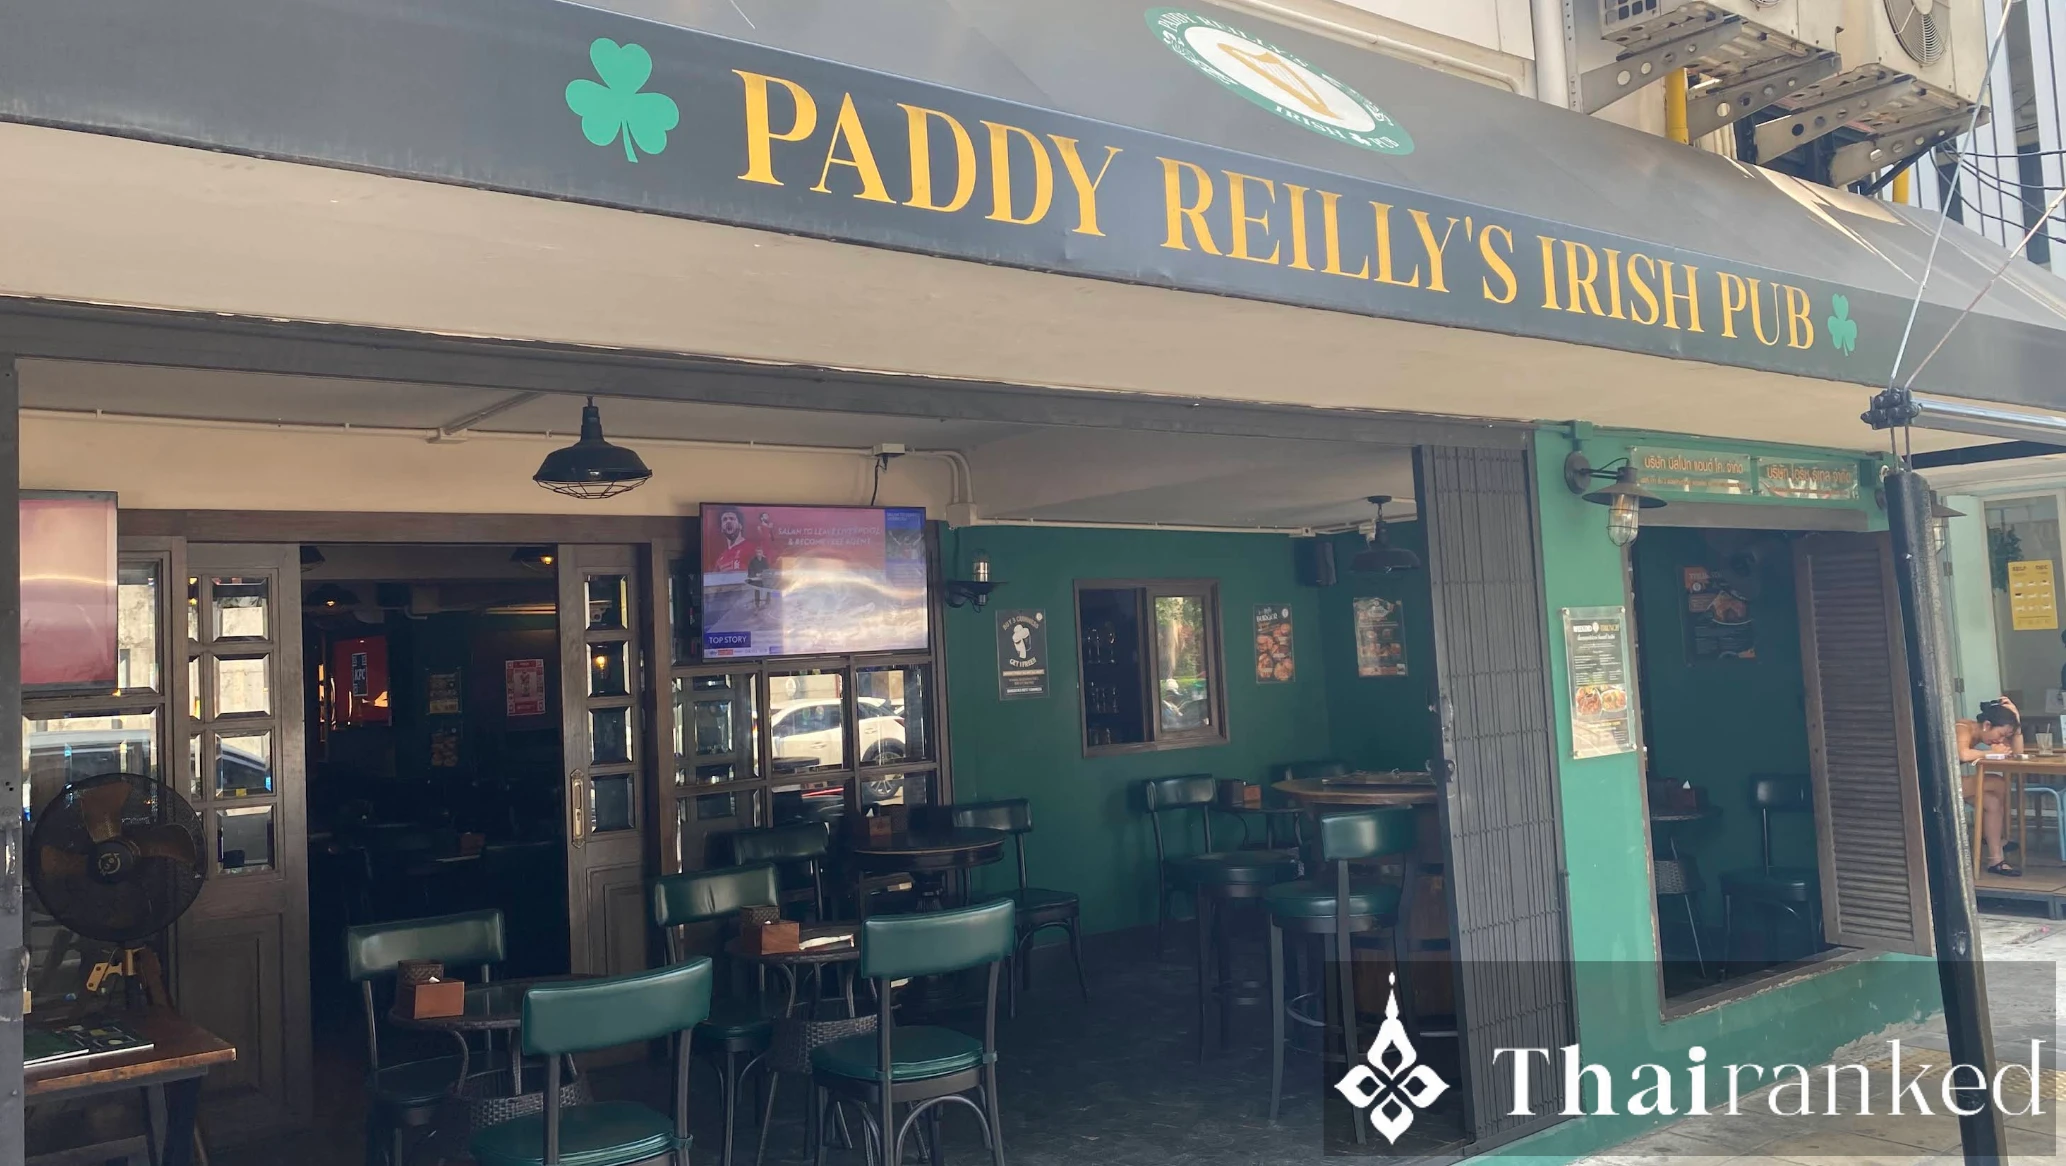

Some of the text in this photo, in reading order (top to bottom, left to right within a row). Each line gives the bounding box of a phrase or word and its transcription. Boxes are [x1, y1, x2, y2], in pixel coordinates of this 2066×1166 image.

[1158, 12, 1309, 67] PADDY REILLY'S
[1275, 105, 1400, 149] IRISH PUB
[732, 69, 1815, 350] PADDY REILLY'S IRISH PUB
[709, 635, 747, 644] TOP STORY
